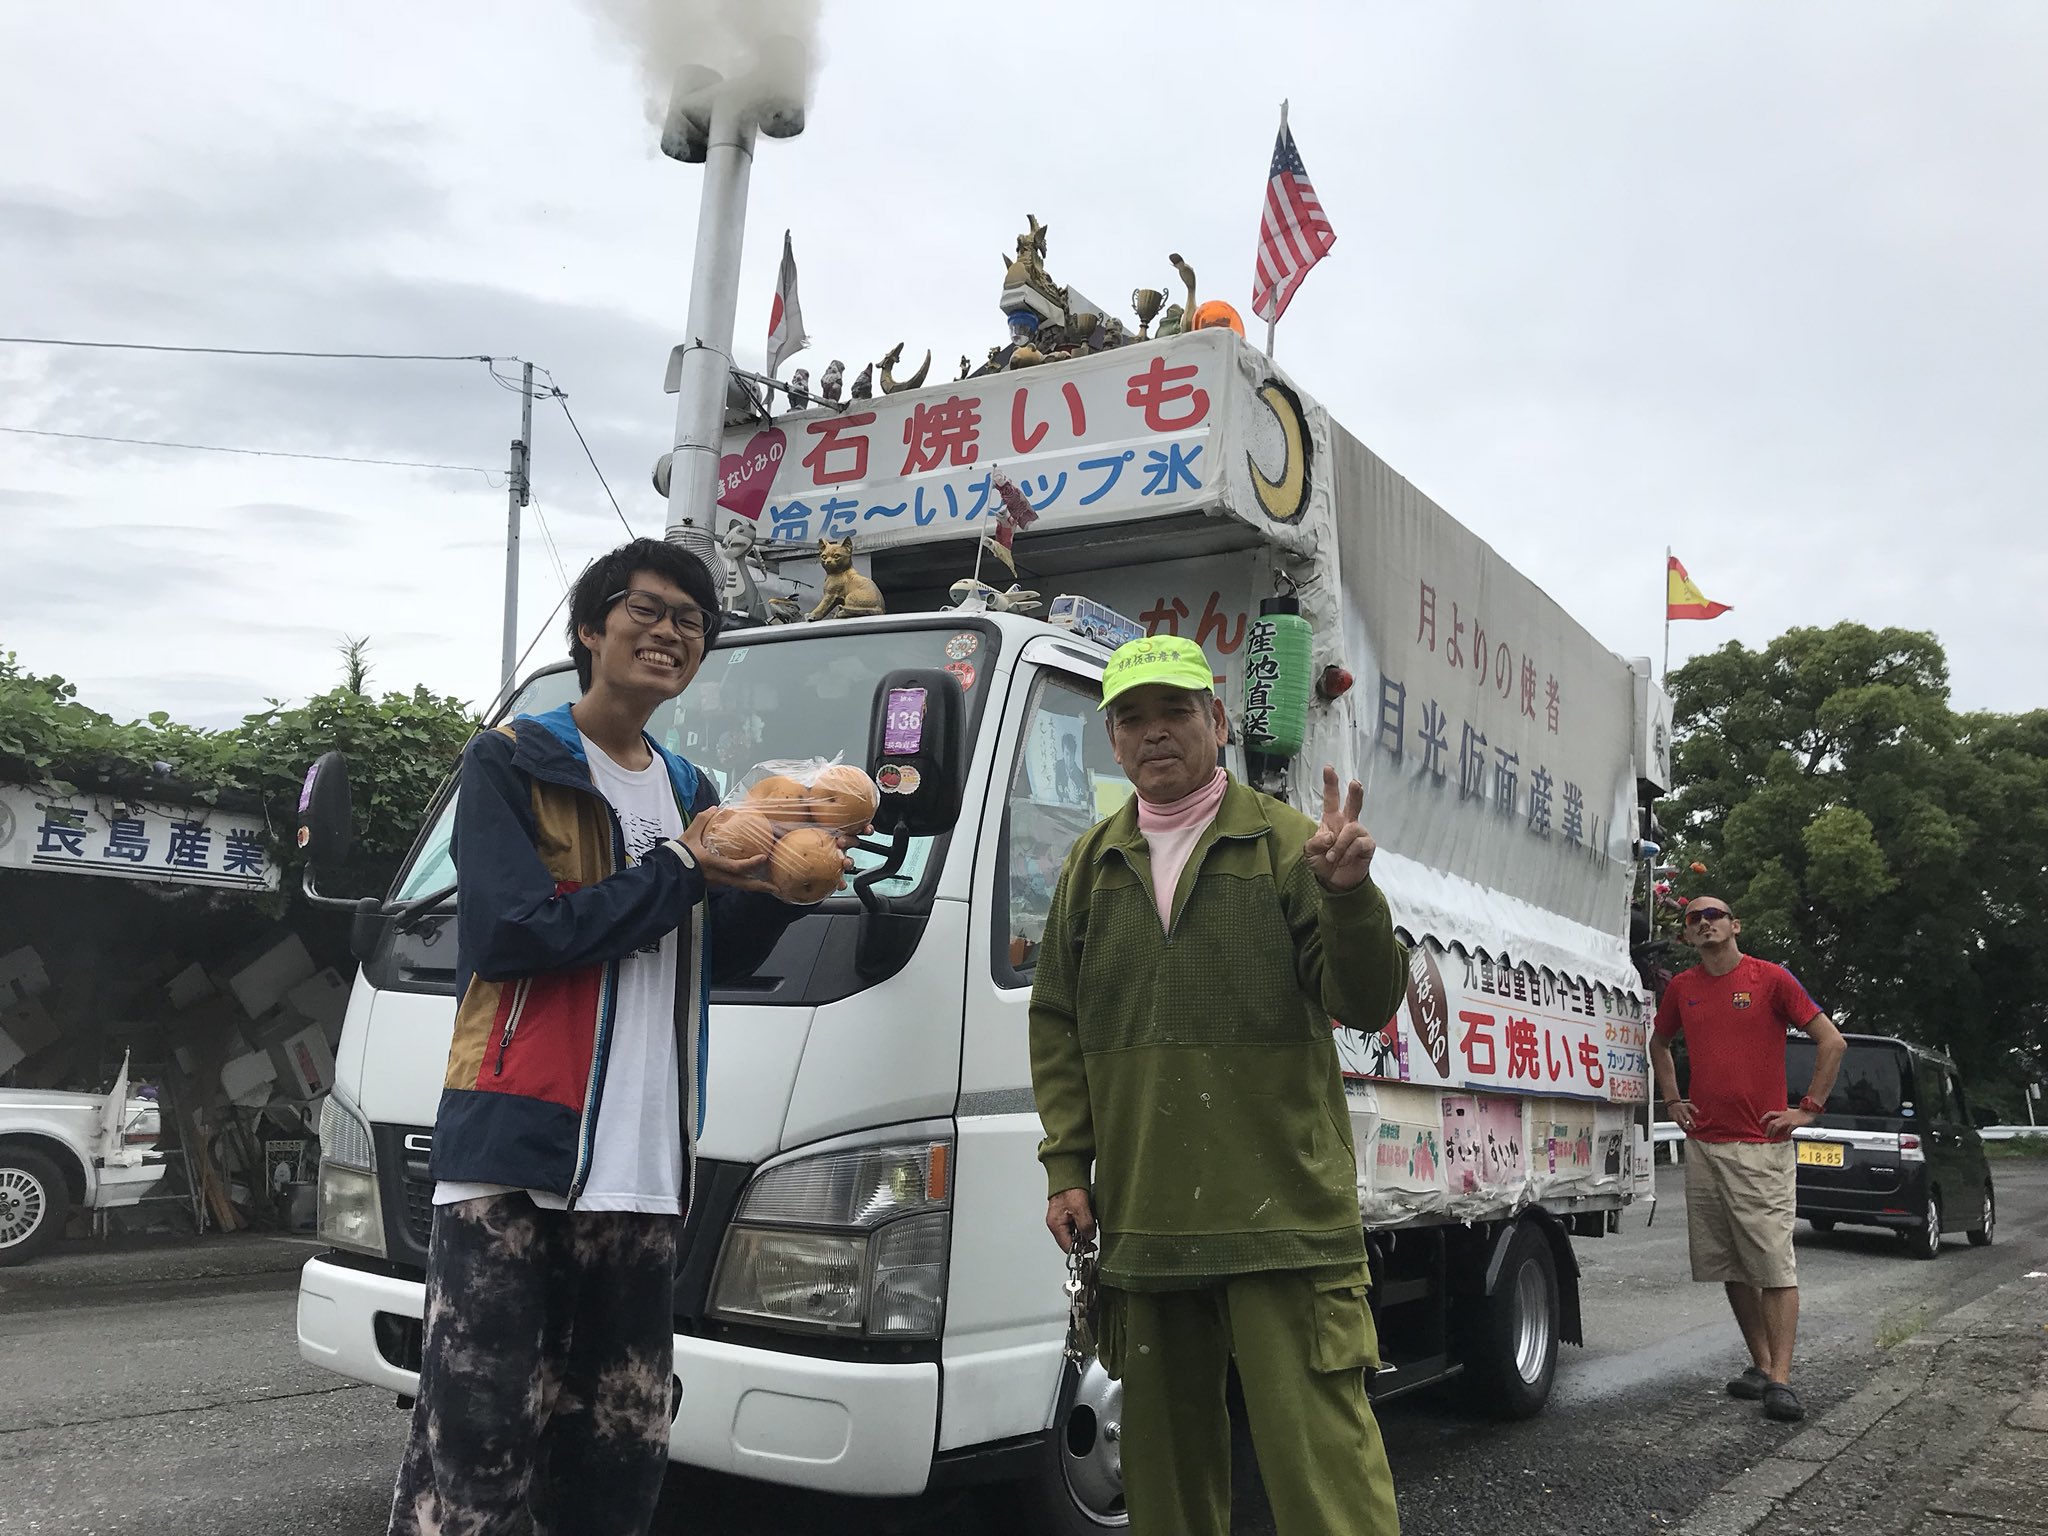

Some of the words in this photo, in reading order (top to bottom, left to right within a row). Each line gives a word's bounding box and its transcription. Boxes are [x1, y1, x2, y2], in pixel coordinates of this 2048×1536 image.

[802, 357, 1210, 486] 石焼いも
[1245, 621, 1279, 742] 産地直送
[1416, 578, 1560, 735] 月よりの使者
[889, 710, 920, 730] 136
[36, 805, 265, 875] 長島産業
[1458, 1009, 1605, 1089] 石焼いも
[1605, 1022, 1647, 1046] みかん
[1607, 1050, 1647, 1074] カップ氷
[1808, 1151, 1842, 1165] 18-85
